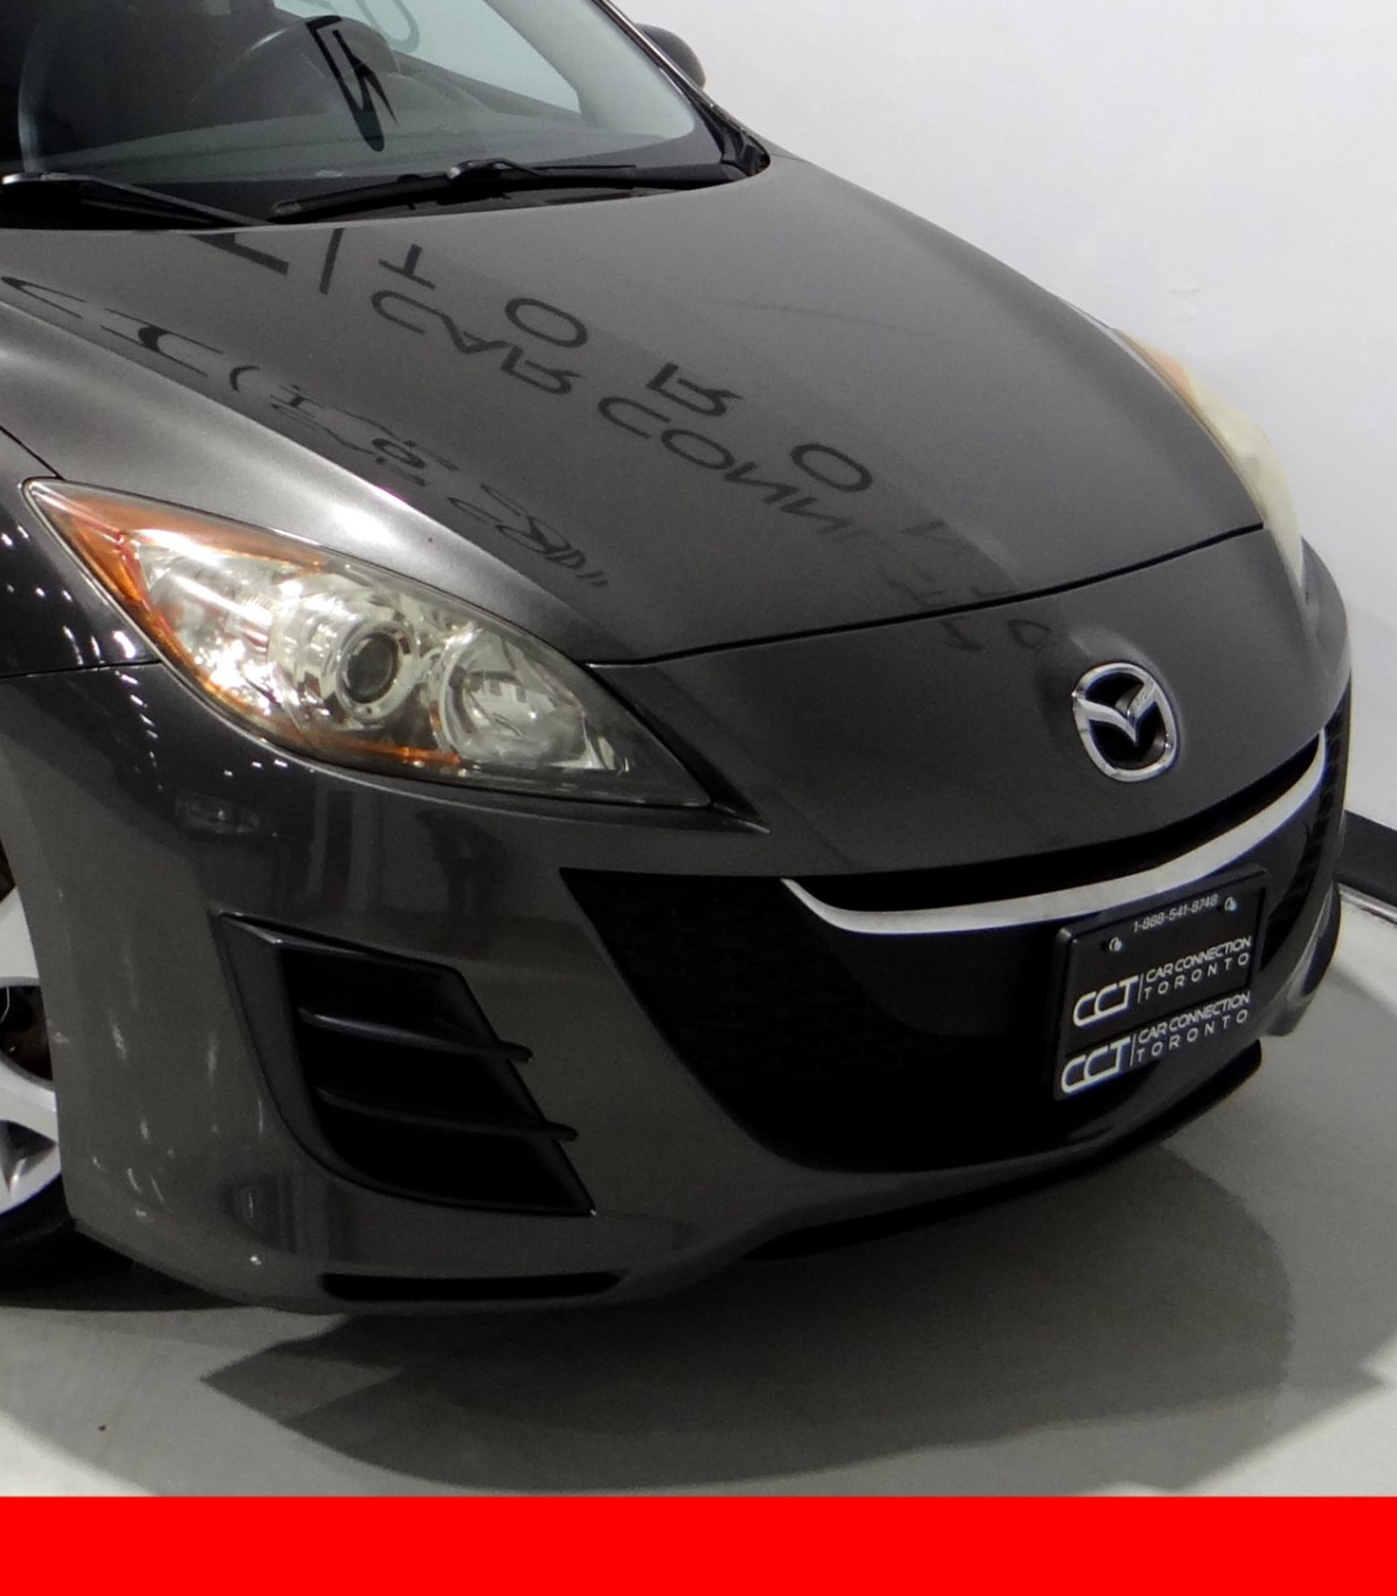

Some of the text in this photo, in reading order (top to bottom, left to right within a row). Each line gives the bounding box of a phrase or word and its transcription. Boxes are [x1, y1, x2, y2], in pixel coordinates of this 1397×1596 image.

[1143, 951, 1250, 1001] TORONTO
[1145, 935, 1253, 983] CAR CONNECTION
[1073, 975, 1139, 1026] CCT
[1137, 990, 1252, 1045] CAR CONNECTION
[1135, 1008, 1249, 1063] TORONTO
[1061, 1036, 1130, 1093] CCT
